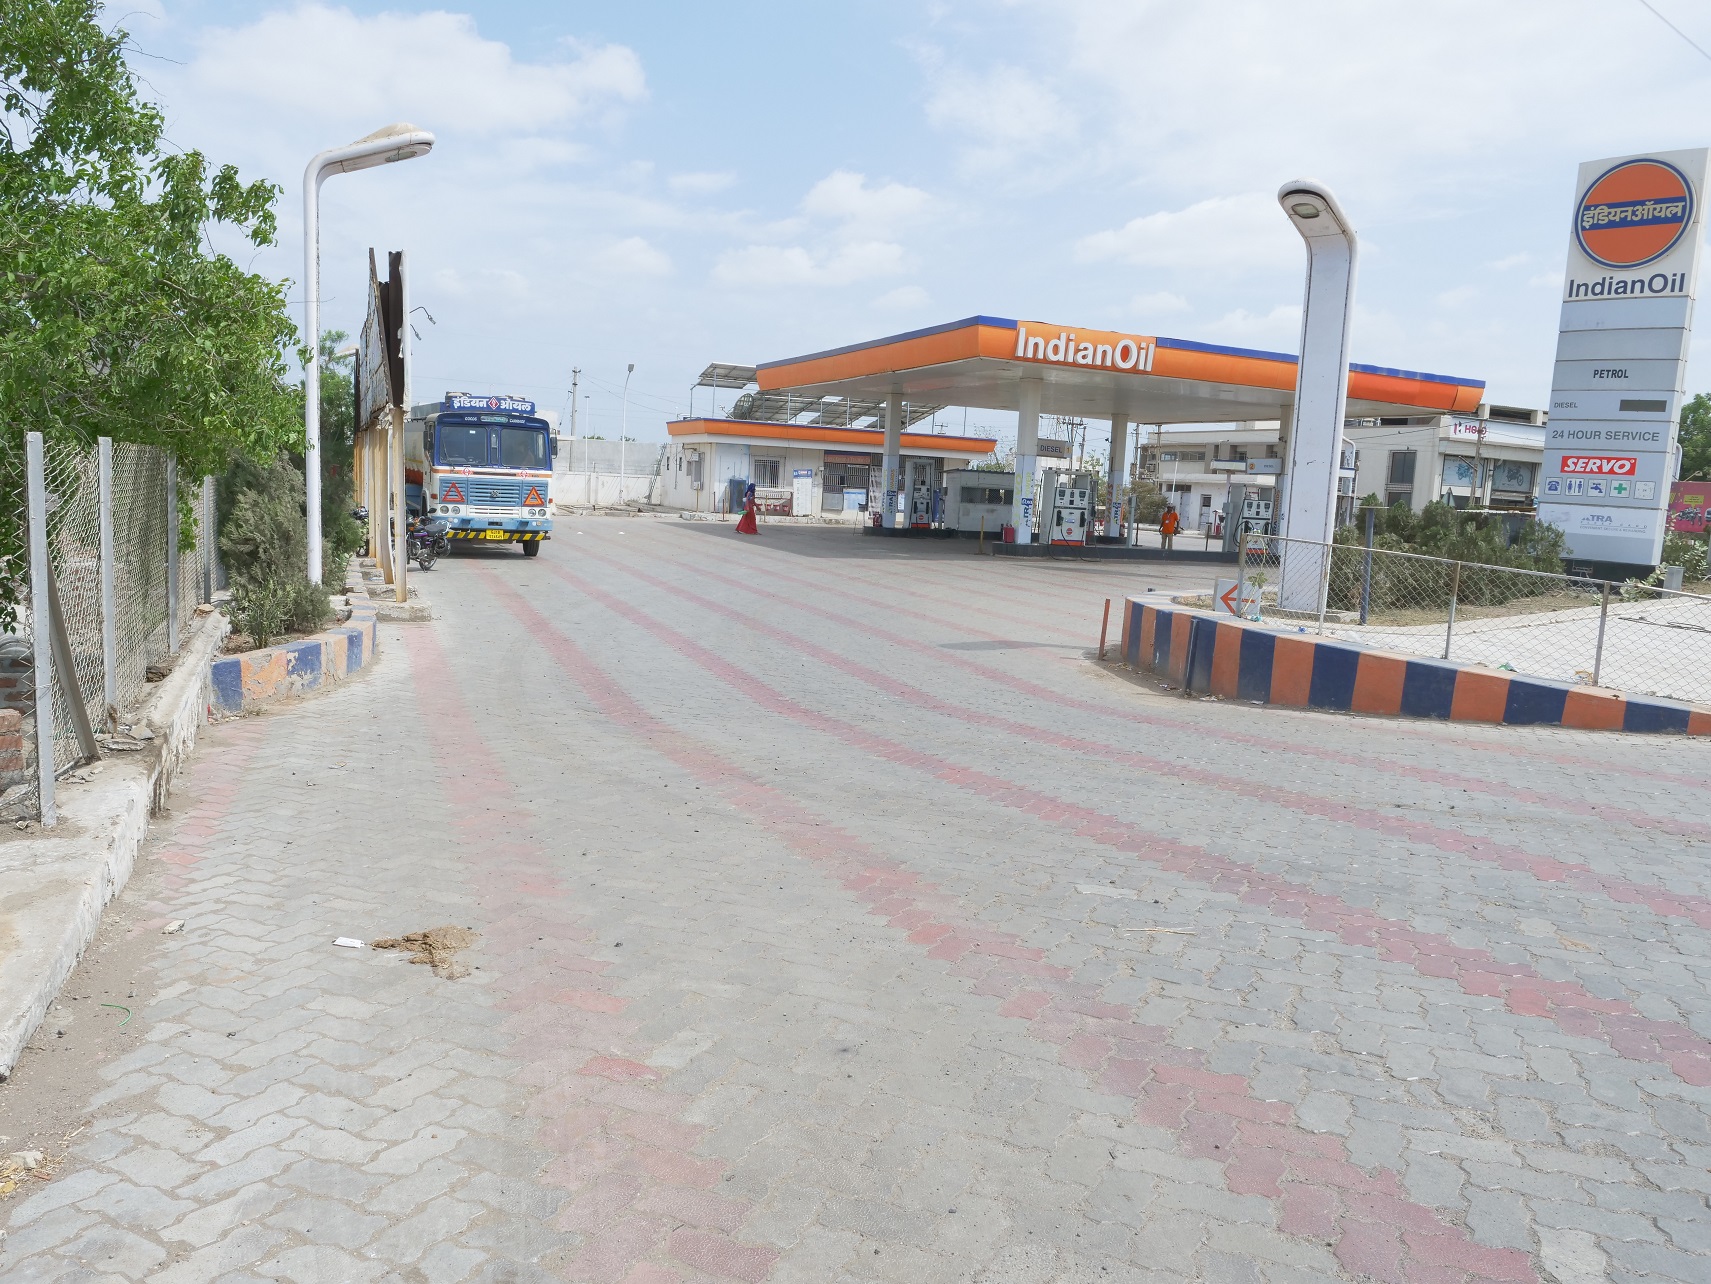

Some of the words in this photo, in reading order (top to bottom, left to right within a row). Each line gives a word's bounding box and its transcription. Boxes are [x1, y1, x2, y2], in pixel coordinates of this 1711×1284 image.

[1581, 201, 1686, 229] इंडियनऑयल
[1568, 272, 1686, 298] IndianOil
[1015, 327, 1155, 372] IndianOil
[1593, 369, 1629, 379] PETROL
[1551, 430, 1565, 439] 24
[1567, 430, 1602, 440] HOUR
[1604, 430, 1660, 442] SERVICE
[1040, 444, 1063, 454] DIESEL
[1563, 458, 1631, 474] SERVO
